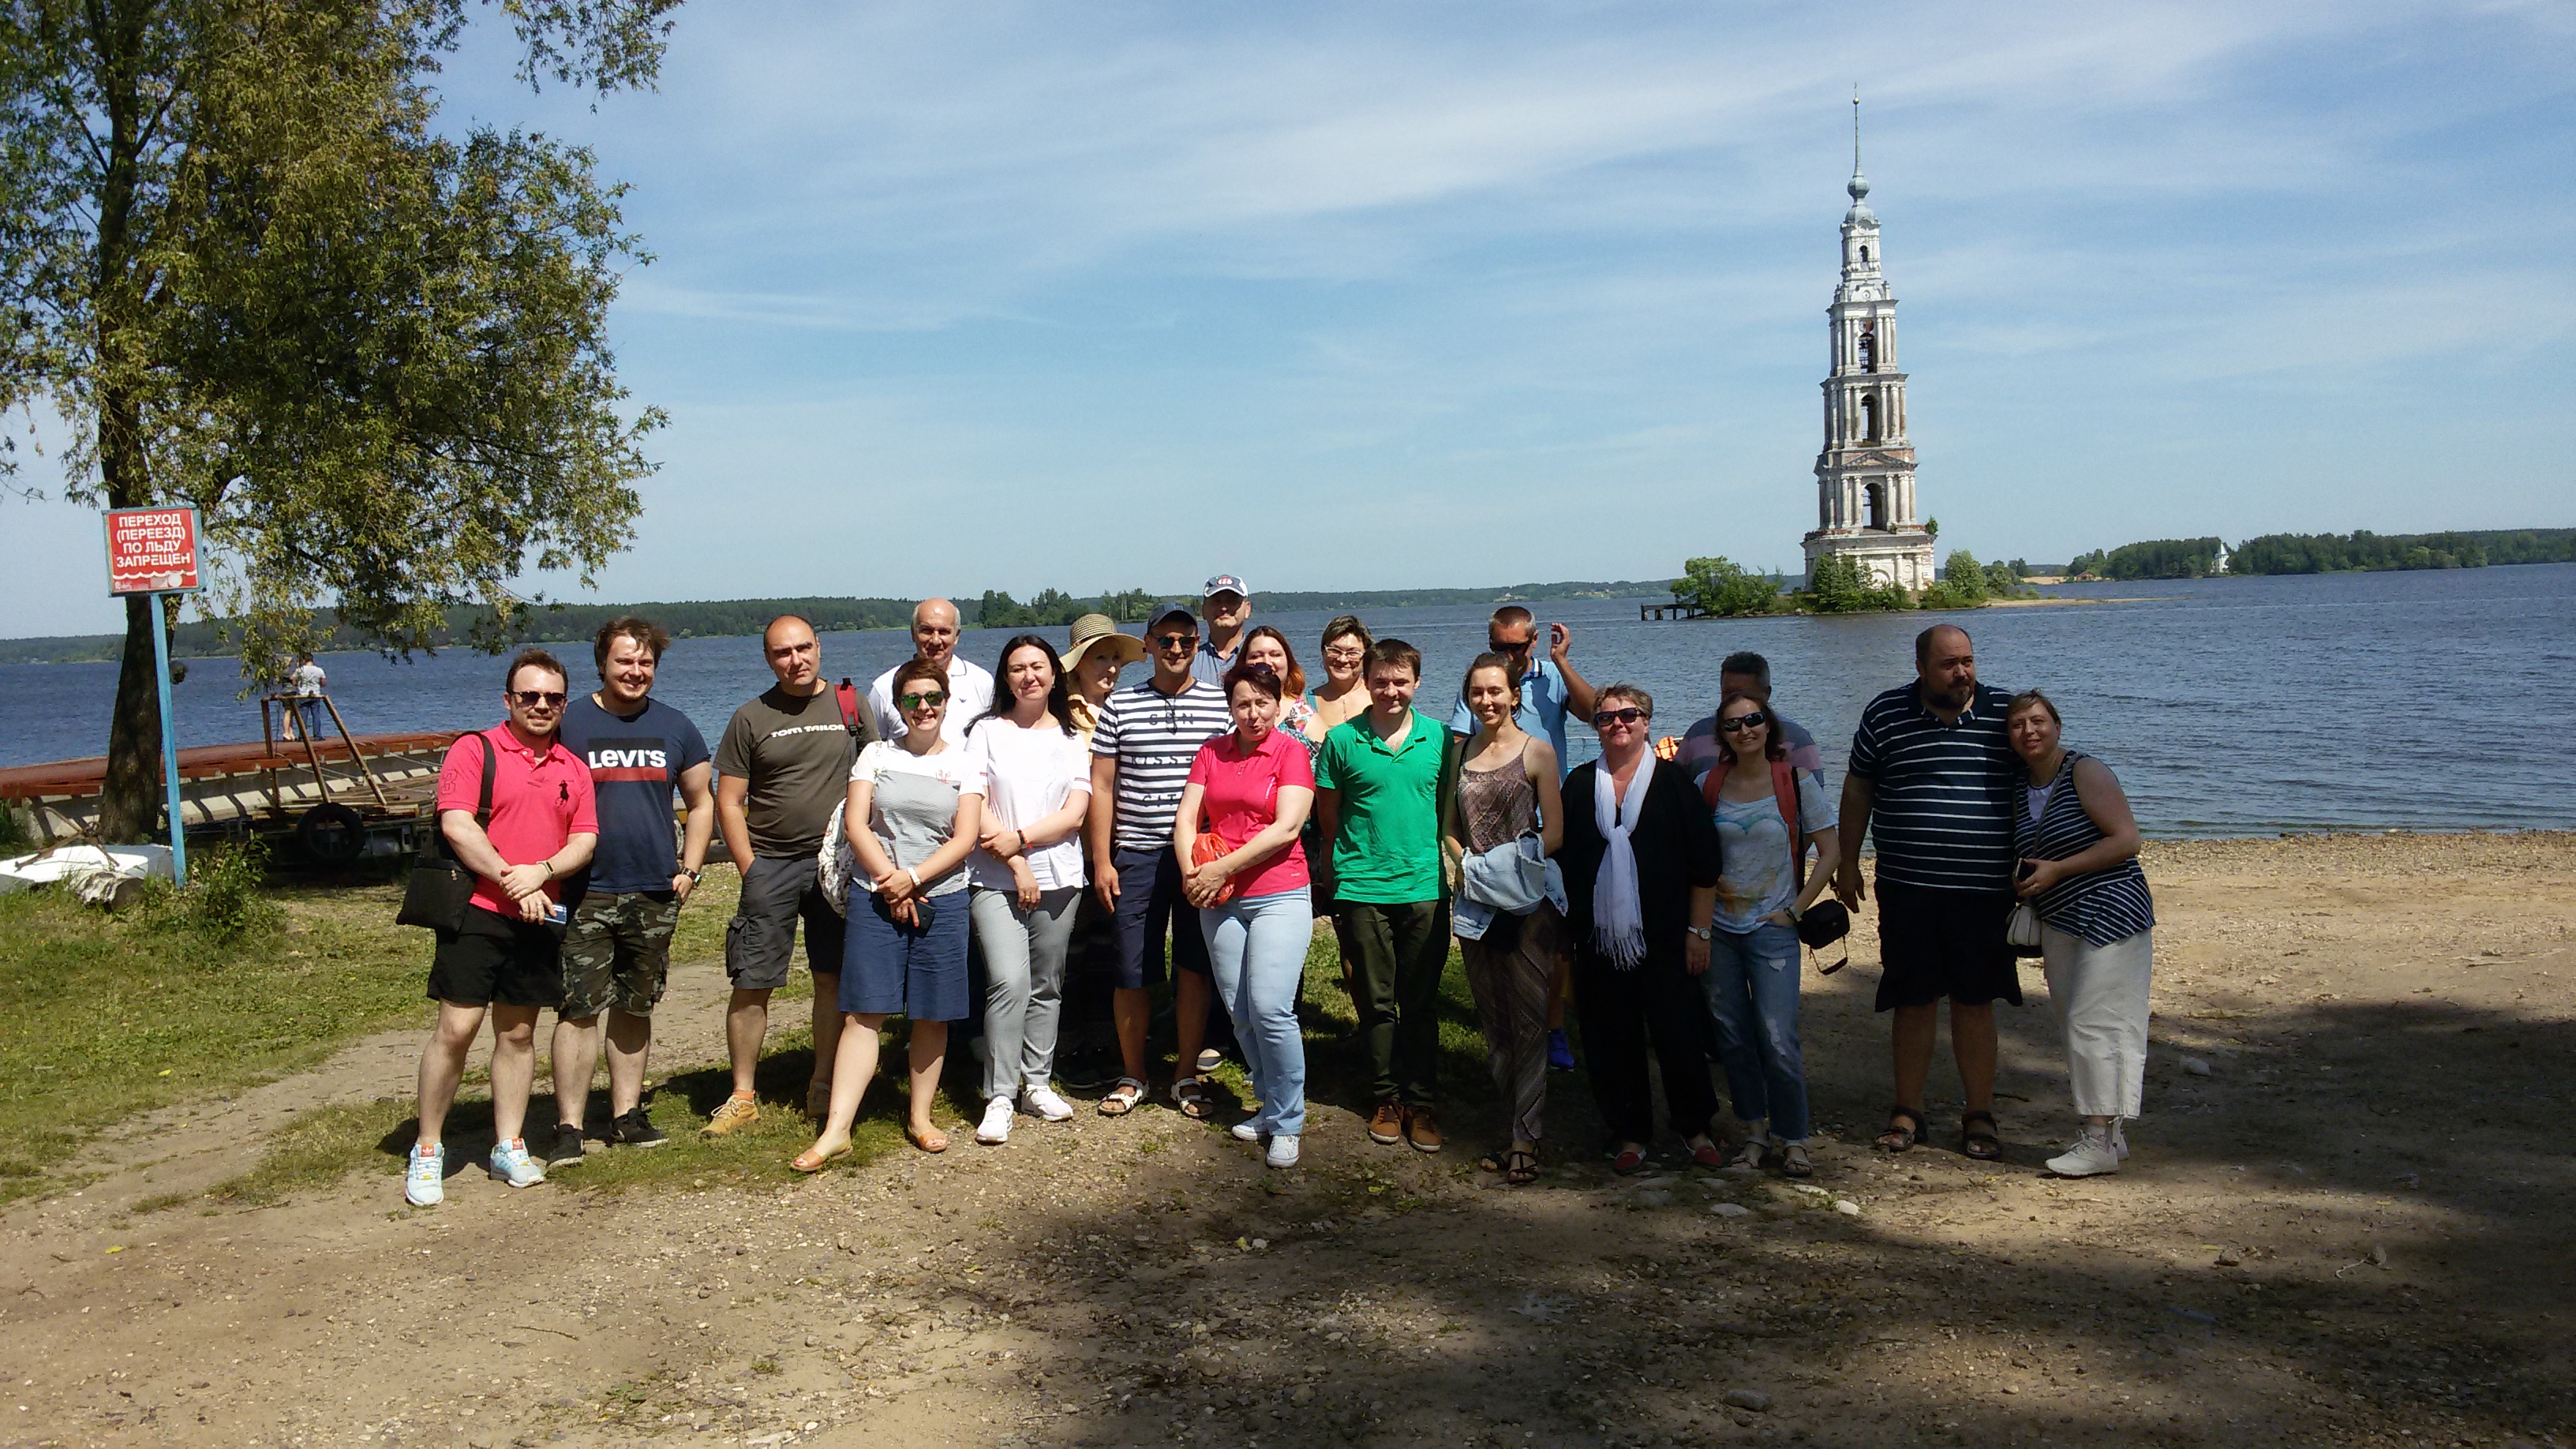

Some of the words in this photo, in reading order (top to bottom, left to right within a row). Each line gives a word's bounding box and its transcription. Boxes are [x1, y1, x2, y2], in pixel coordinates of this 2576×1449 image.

[118, 514, 182, 527] ПЕРЕХОД
[117, 526, 185, 543] (ПЕРЕЕЗД)
[123, 542, 142, 554] ПО
[145, 540, 181, 553] ЛЬДУ
[116, 552, 190, 567] ЗАПРЕЩЕН
[770, 727, 803, 738] TOM
[803, 724, 845, 732] TAILOR
